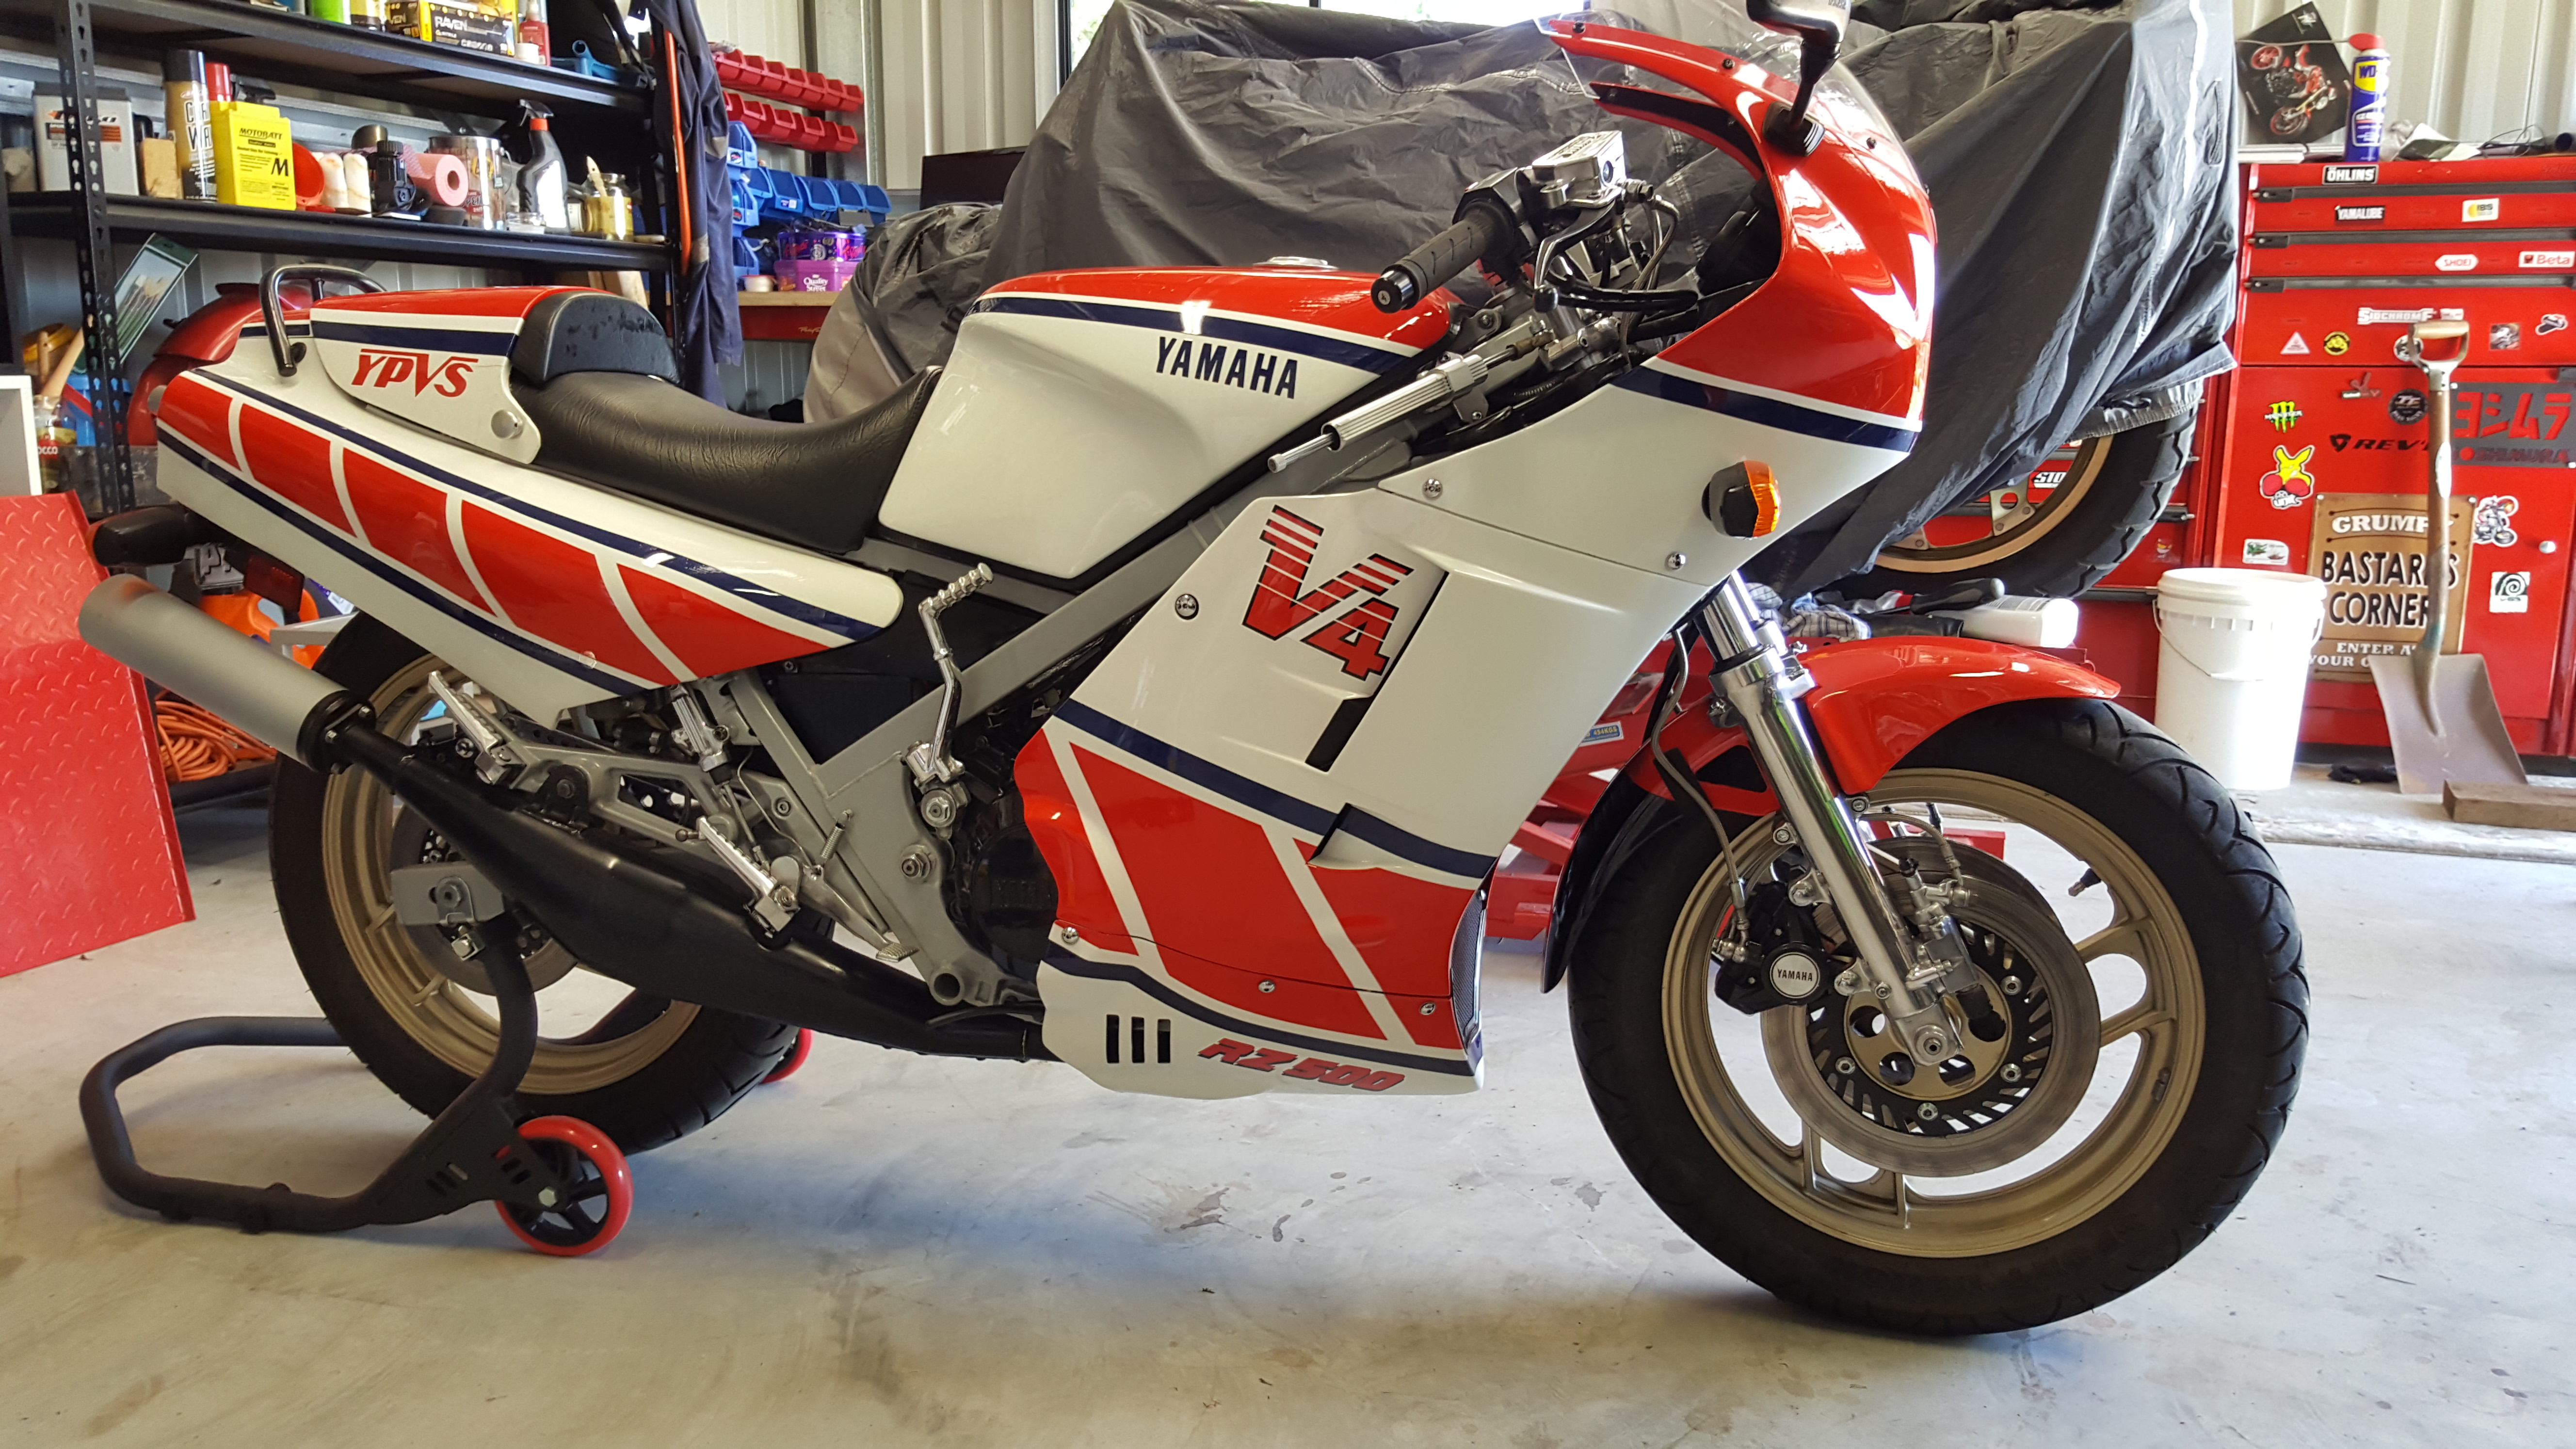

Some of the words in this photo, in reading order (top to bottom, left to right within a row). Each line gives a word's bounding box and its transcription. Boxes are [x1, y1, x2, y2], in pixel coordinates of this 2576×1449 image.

[435, 16, 467, 31] RAVEN
[271, 158, 289, 177] M
[2326, 166, 2376, 182] ÖHLINS
[2337, 207, 2385, 220] YAMALUBE
[2536, 254, 2570, 265] Beta
[804, 277, 828, 287] Quality
[351, 349, 479, 398] YPVS
[1156, 336, 1298, 399] YAMAHA
[2454, 391, 2572, 440] ヨシムラ
[2331, 514, 2453, 533] GRUMP
[2322, 551, 2460, 589] BASTARS
[1241, 504, 1415, 681] V4
[2336, 642, 2394, 655] ENTER
[2400, 644, 2416, 656] A
[1777, 968, 1813, 982] YAMAHA
[1198, 1038, 1298, 1072] RZ
[1281, 1057, 1405, 1091] 500
